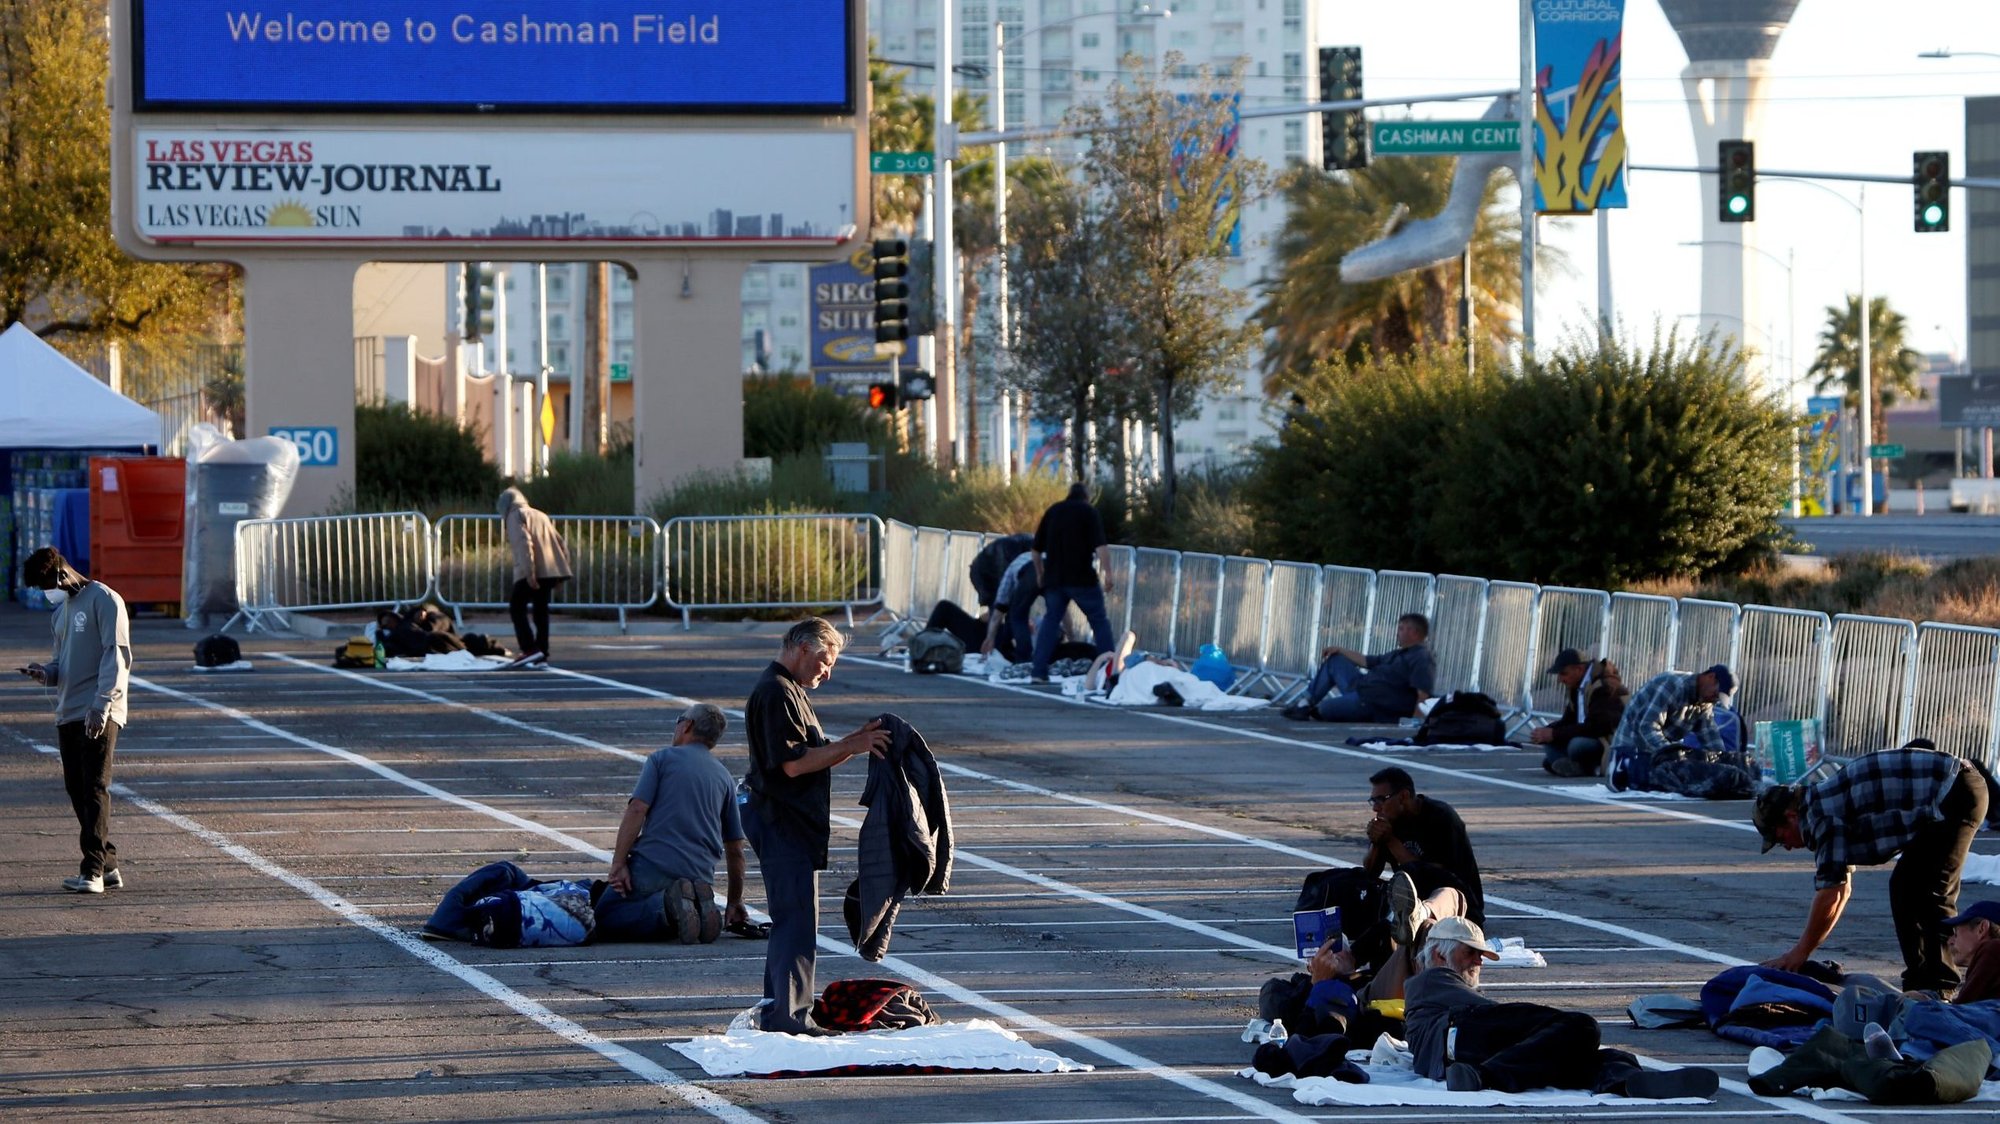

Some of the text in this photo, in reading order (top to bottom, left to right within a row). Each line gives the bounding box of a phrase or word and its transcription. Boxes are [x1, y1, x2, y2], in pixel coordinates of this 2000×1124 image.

[1539, 0, 1617, 10] CULTURAL
[1539, 10, 1620, 21] CORRIDOR
[227, 12, 719, 43] Welcome to Cashman Field
[1378, 127, 1537, 145] CASHMAN CENT
[146, 140, 313, 163] LAS VEGAS
[146, 163, 501, 195] REVIEW-JOURNAL
[148, 203, 361, 228] LAS VEGAS SUN
